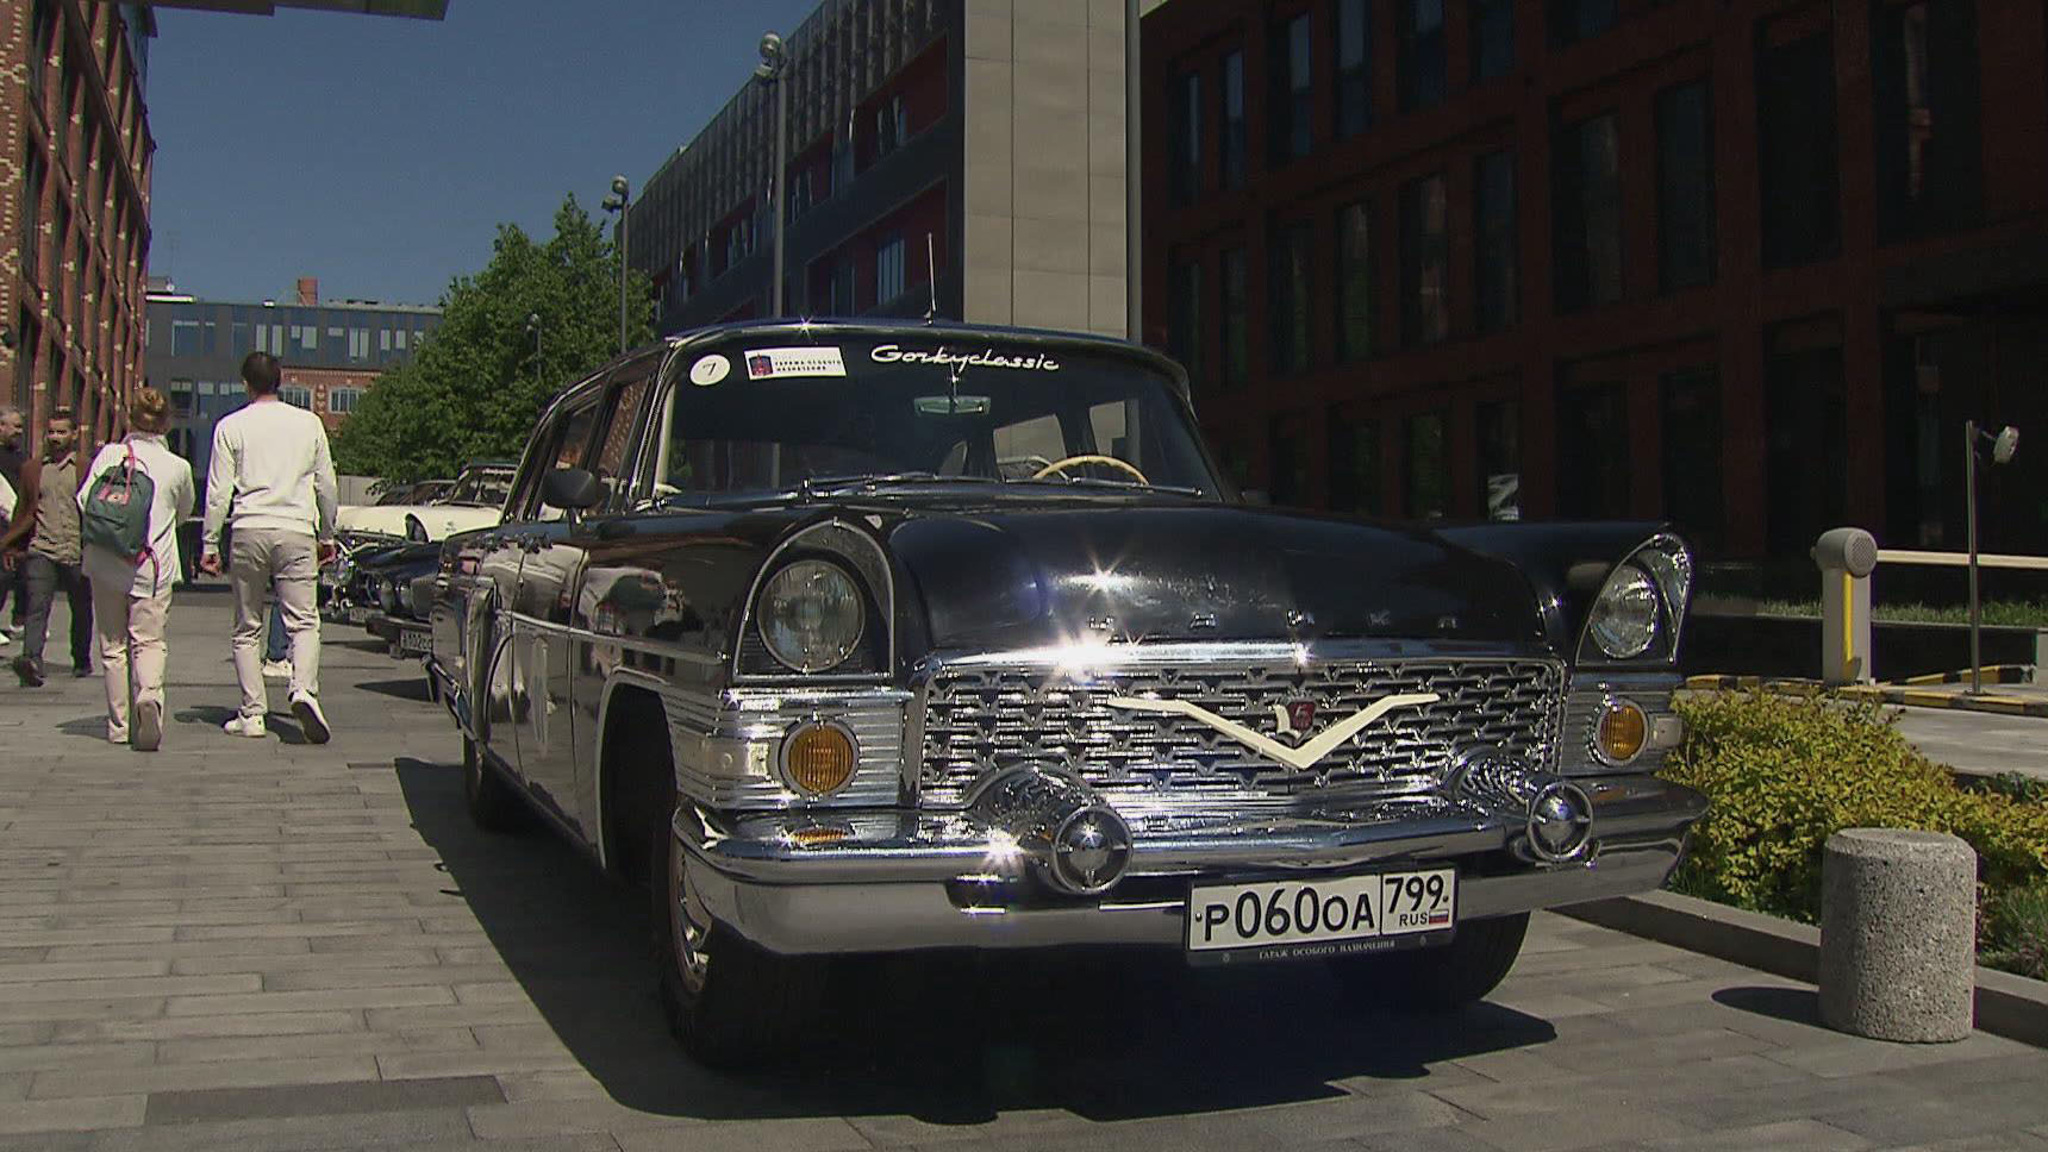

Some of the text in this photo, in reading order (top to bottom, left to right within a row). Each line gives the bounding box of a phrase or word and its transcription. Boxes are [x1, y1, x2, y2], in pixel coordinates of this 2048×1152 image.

[702, 362, 717, 376] 7
[870, 345, 1060, 373] Gorkyclassic
[1384, 874, 1446, 914] 799
[1399, 911, 1428, 927] RUS
